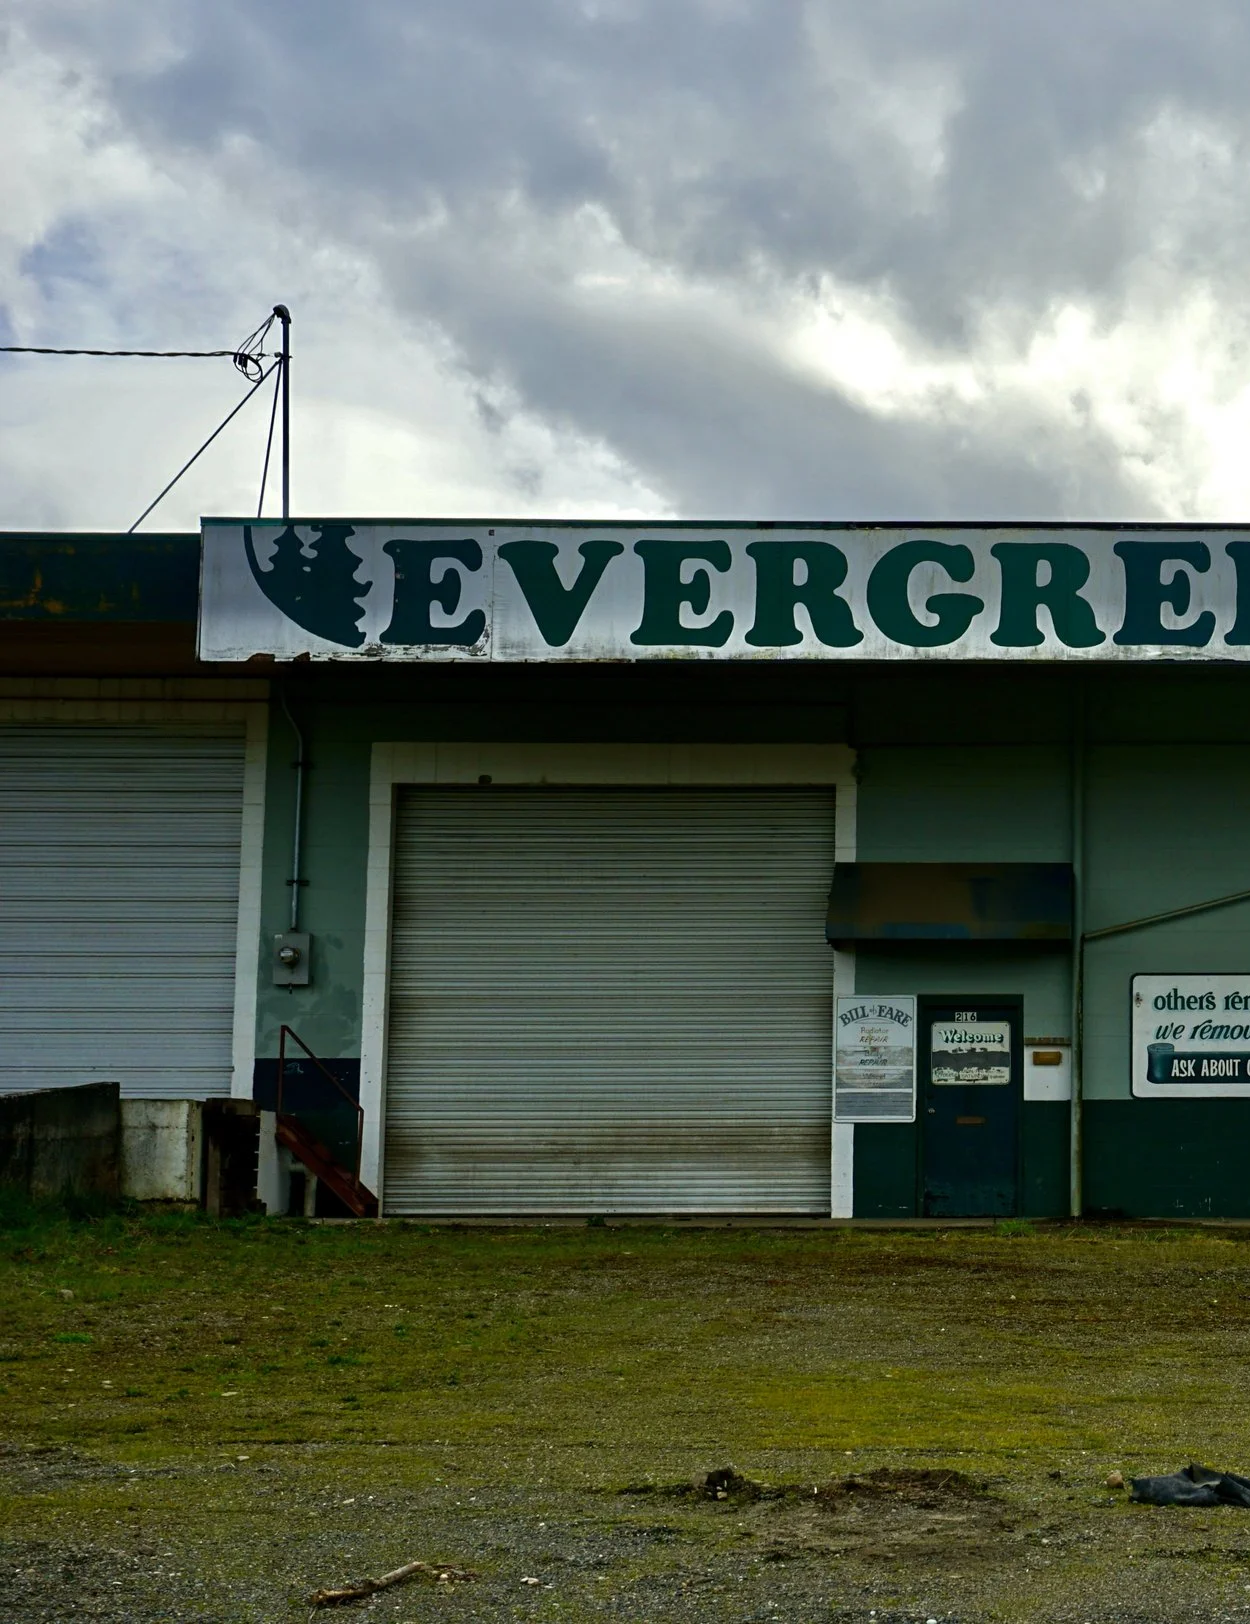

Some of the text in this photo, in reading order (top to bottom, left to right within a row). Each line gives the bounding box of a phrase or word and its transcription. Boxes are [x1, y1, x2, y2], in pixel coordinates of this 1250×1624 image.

[1153, 988, 1216, 1011] others
[838, 1005, 869, 1027] BILL
[876, 1004, 912, 1027] FARE
[956, 1012, 976, 1022] 216
[860, 1026, 889, 1034] Radiator
[938, 1028, 1004, 1044] Welcome
[1155, 1022, 1185, 1040] we
[1171, 1058, 1196, 1078] ASK
[1201, 1058, 1241, 1077] ABOUT
